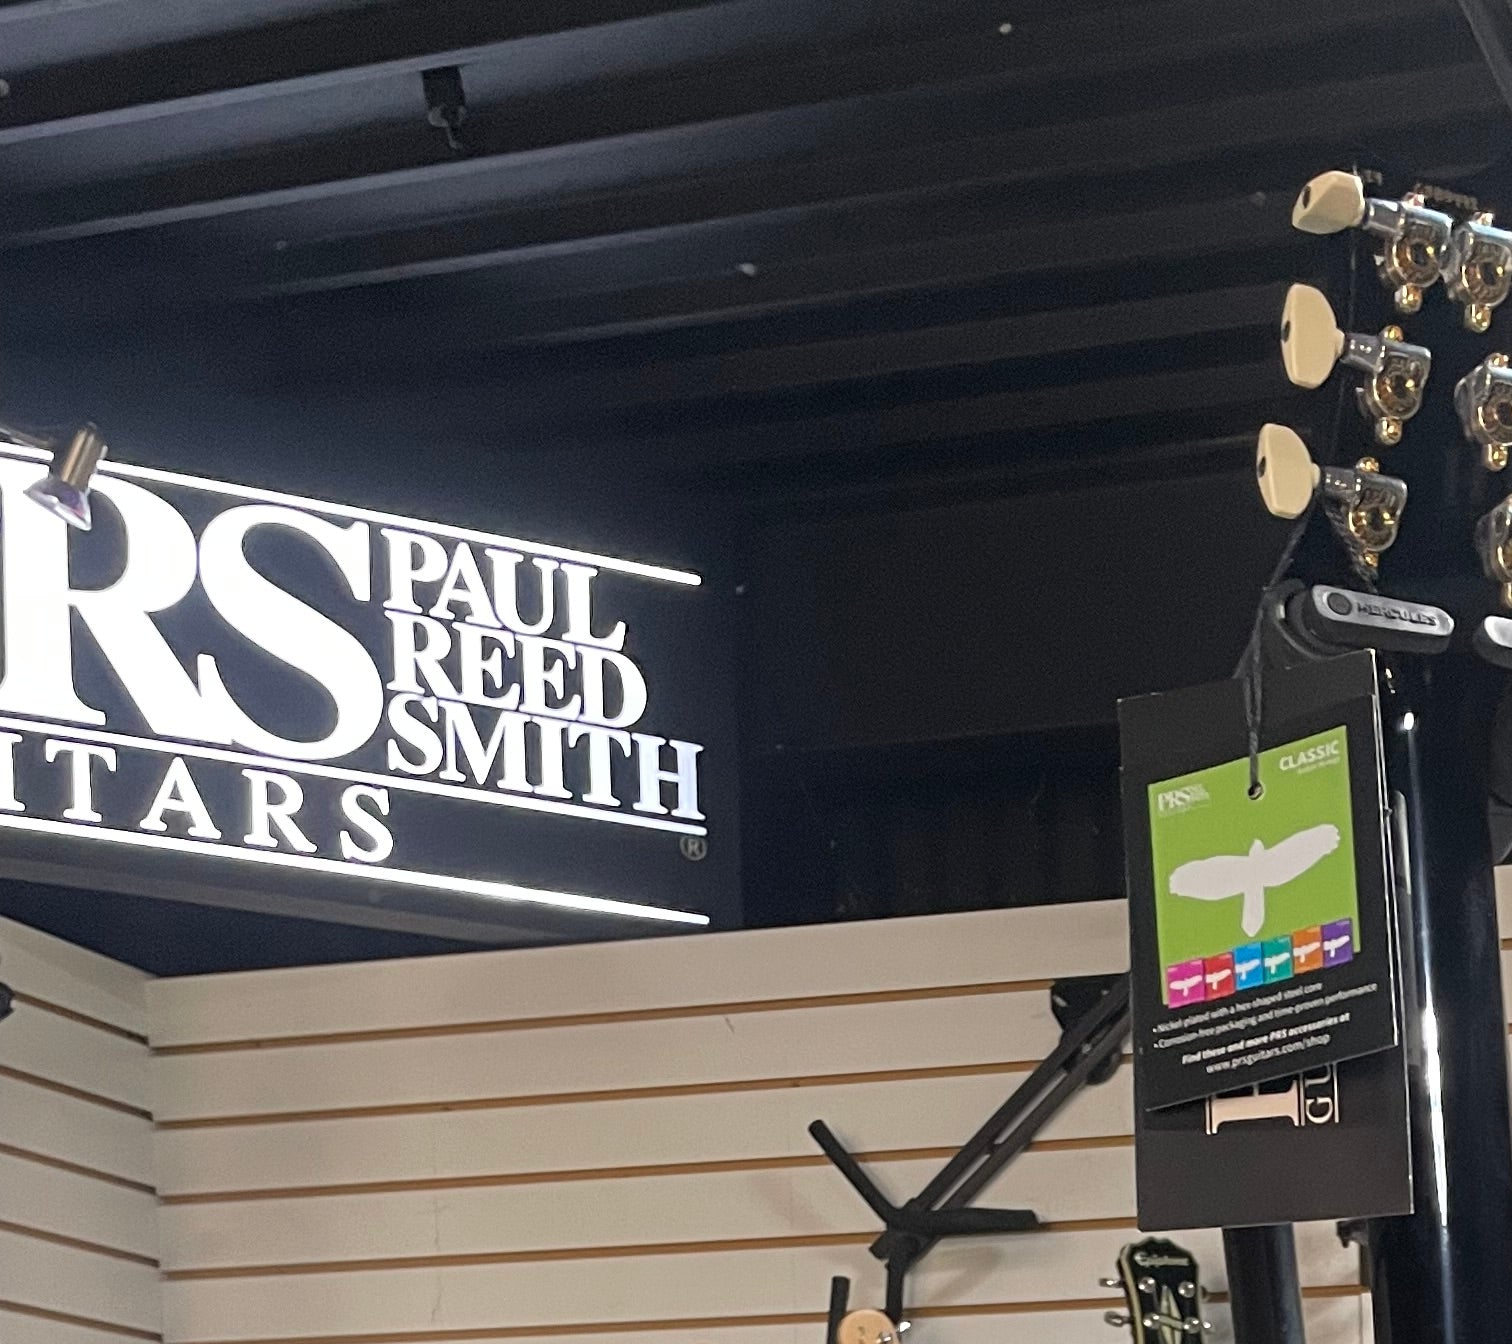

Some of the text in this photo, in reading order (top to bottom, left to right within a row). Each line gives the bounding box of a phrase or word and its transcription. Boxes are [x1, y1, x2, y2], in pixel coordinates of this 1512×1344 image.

[380, 528, 626, 651] PAUL
[384, 608, 648, 730] REED
[0, 733, 394, 864] ITARS
[386, 695, 706, 820] SMITH
[1279, 740, 1340, 771] CLASSIC
[1270, 1029, 1288, 1042] PRS
